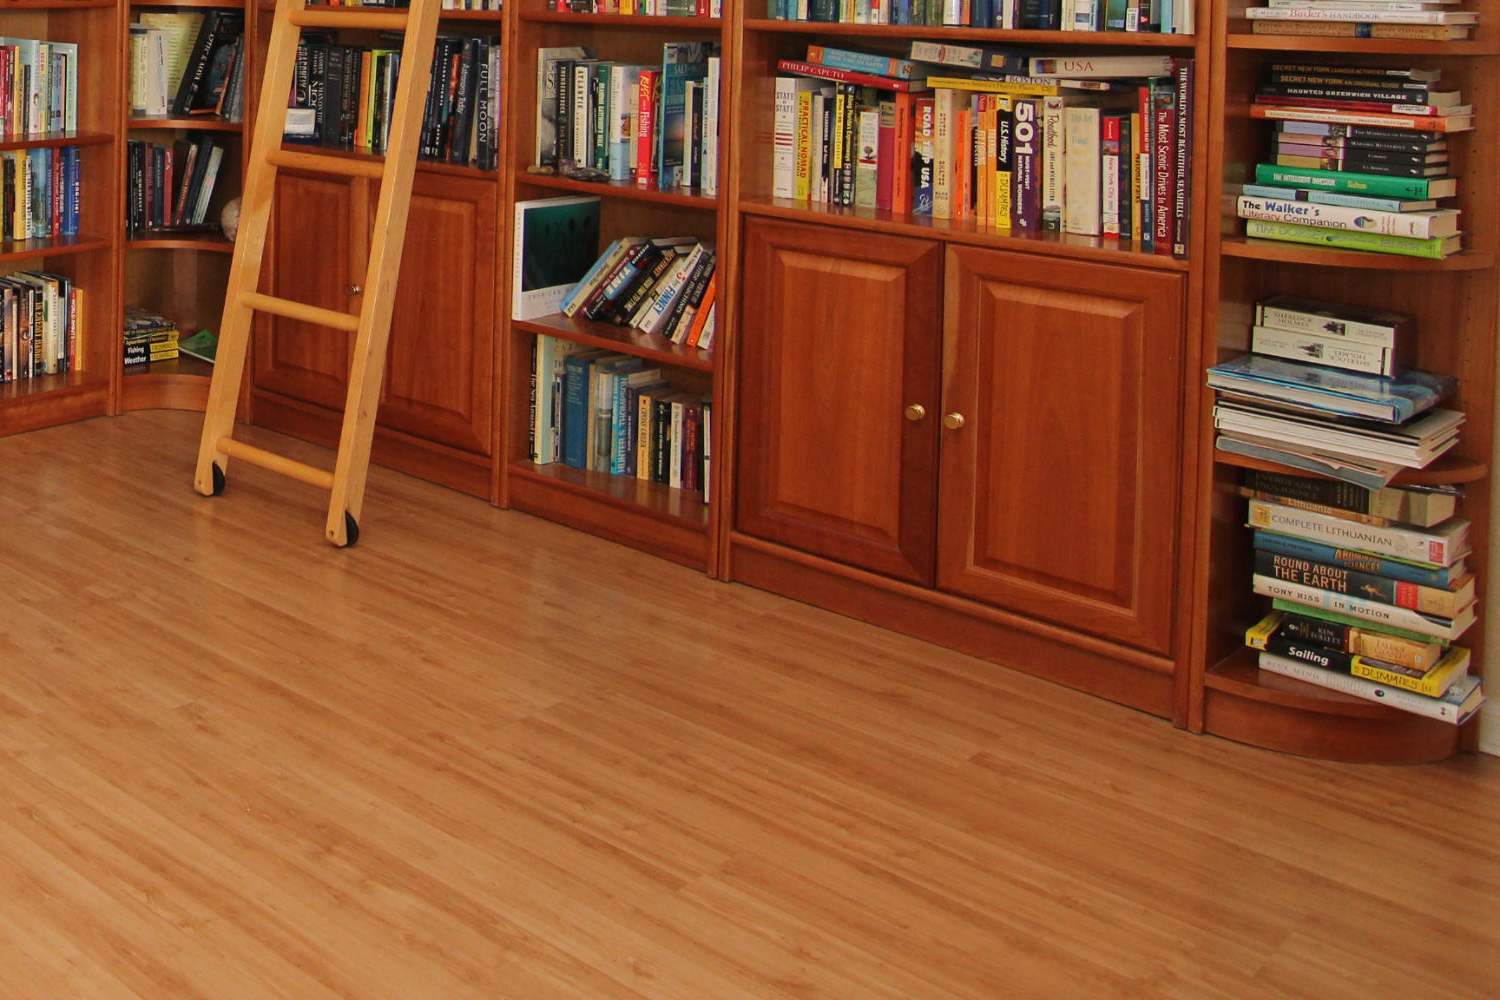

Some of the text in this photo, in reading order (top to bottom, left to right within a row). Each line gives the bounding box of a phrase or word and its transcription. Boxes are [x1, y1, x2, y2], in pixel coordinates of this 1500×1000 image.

[782, 63, 844, 79] PHILIP CAPUTO
[1064, 60, 1095, 72] USA
[457, 63, 469, 115] Astronomy Today
[776, 91, 794, 101] STATE
[478, 63, 488, 143] FULL MOON
[776, 104, 794, 113] STATE
[639, 111, 650, 138] Fishing
[846, 109, 854, 129] Florida's
[1014, 102, 1034, 155] 501
[1159, 112, 1167, 122] The
[800, 100, 810, 178] PRACTICAL NOMAD
[999, 120, 1009, 163] U.S. History
[1047, 114, 1059, 148] Roadfood
[1158, 124, 1169, 144] Most
[921, 106, 932, 189] ROAD TRIP USA
[1157, 145, 1168, 170] Scenic
[1157, 171, 1168, 196] Drives
[1157, 205, 1168, 237] America
[1242, 201, 1321, 216] The Walker's
[1242, 209, 1347, 229] Literary Companion
[124, 356, 147, 365] Weather
[128, 346, 145, 354] Fishing
[619, 377, 628, 427] THOMPSON
[1271, 514, 1393, 547] COMPLETE LITHUANIAN
[1273, 555, 1349, 580] ROUND ABOUT
[1273, 566, 1347, 592] THE EARTH
[1268, 586, 1390, 619] TONY HISS IN MOTION
[1288, 647, 1329, 666] Sailing
[1361, 665, 1418, 689] DUMMIES
